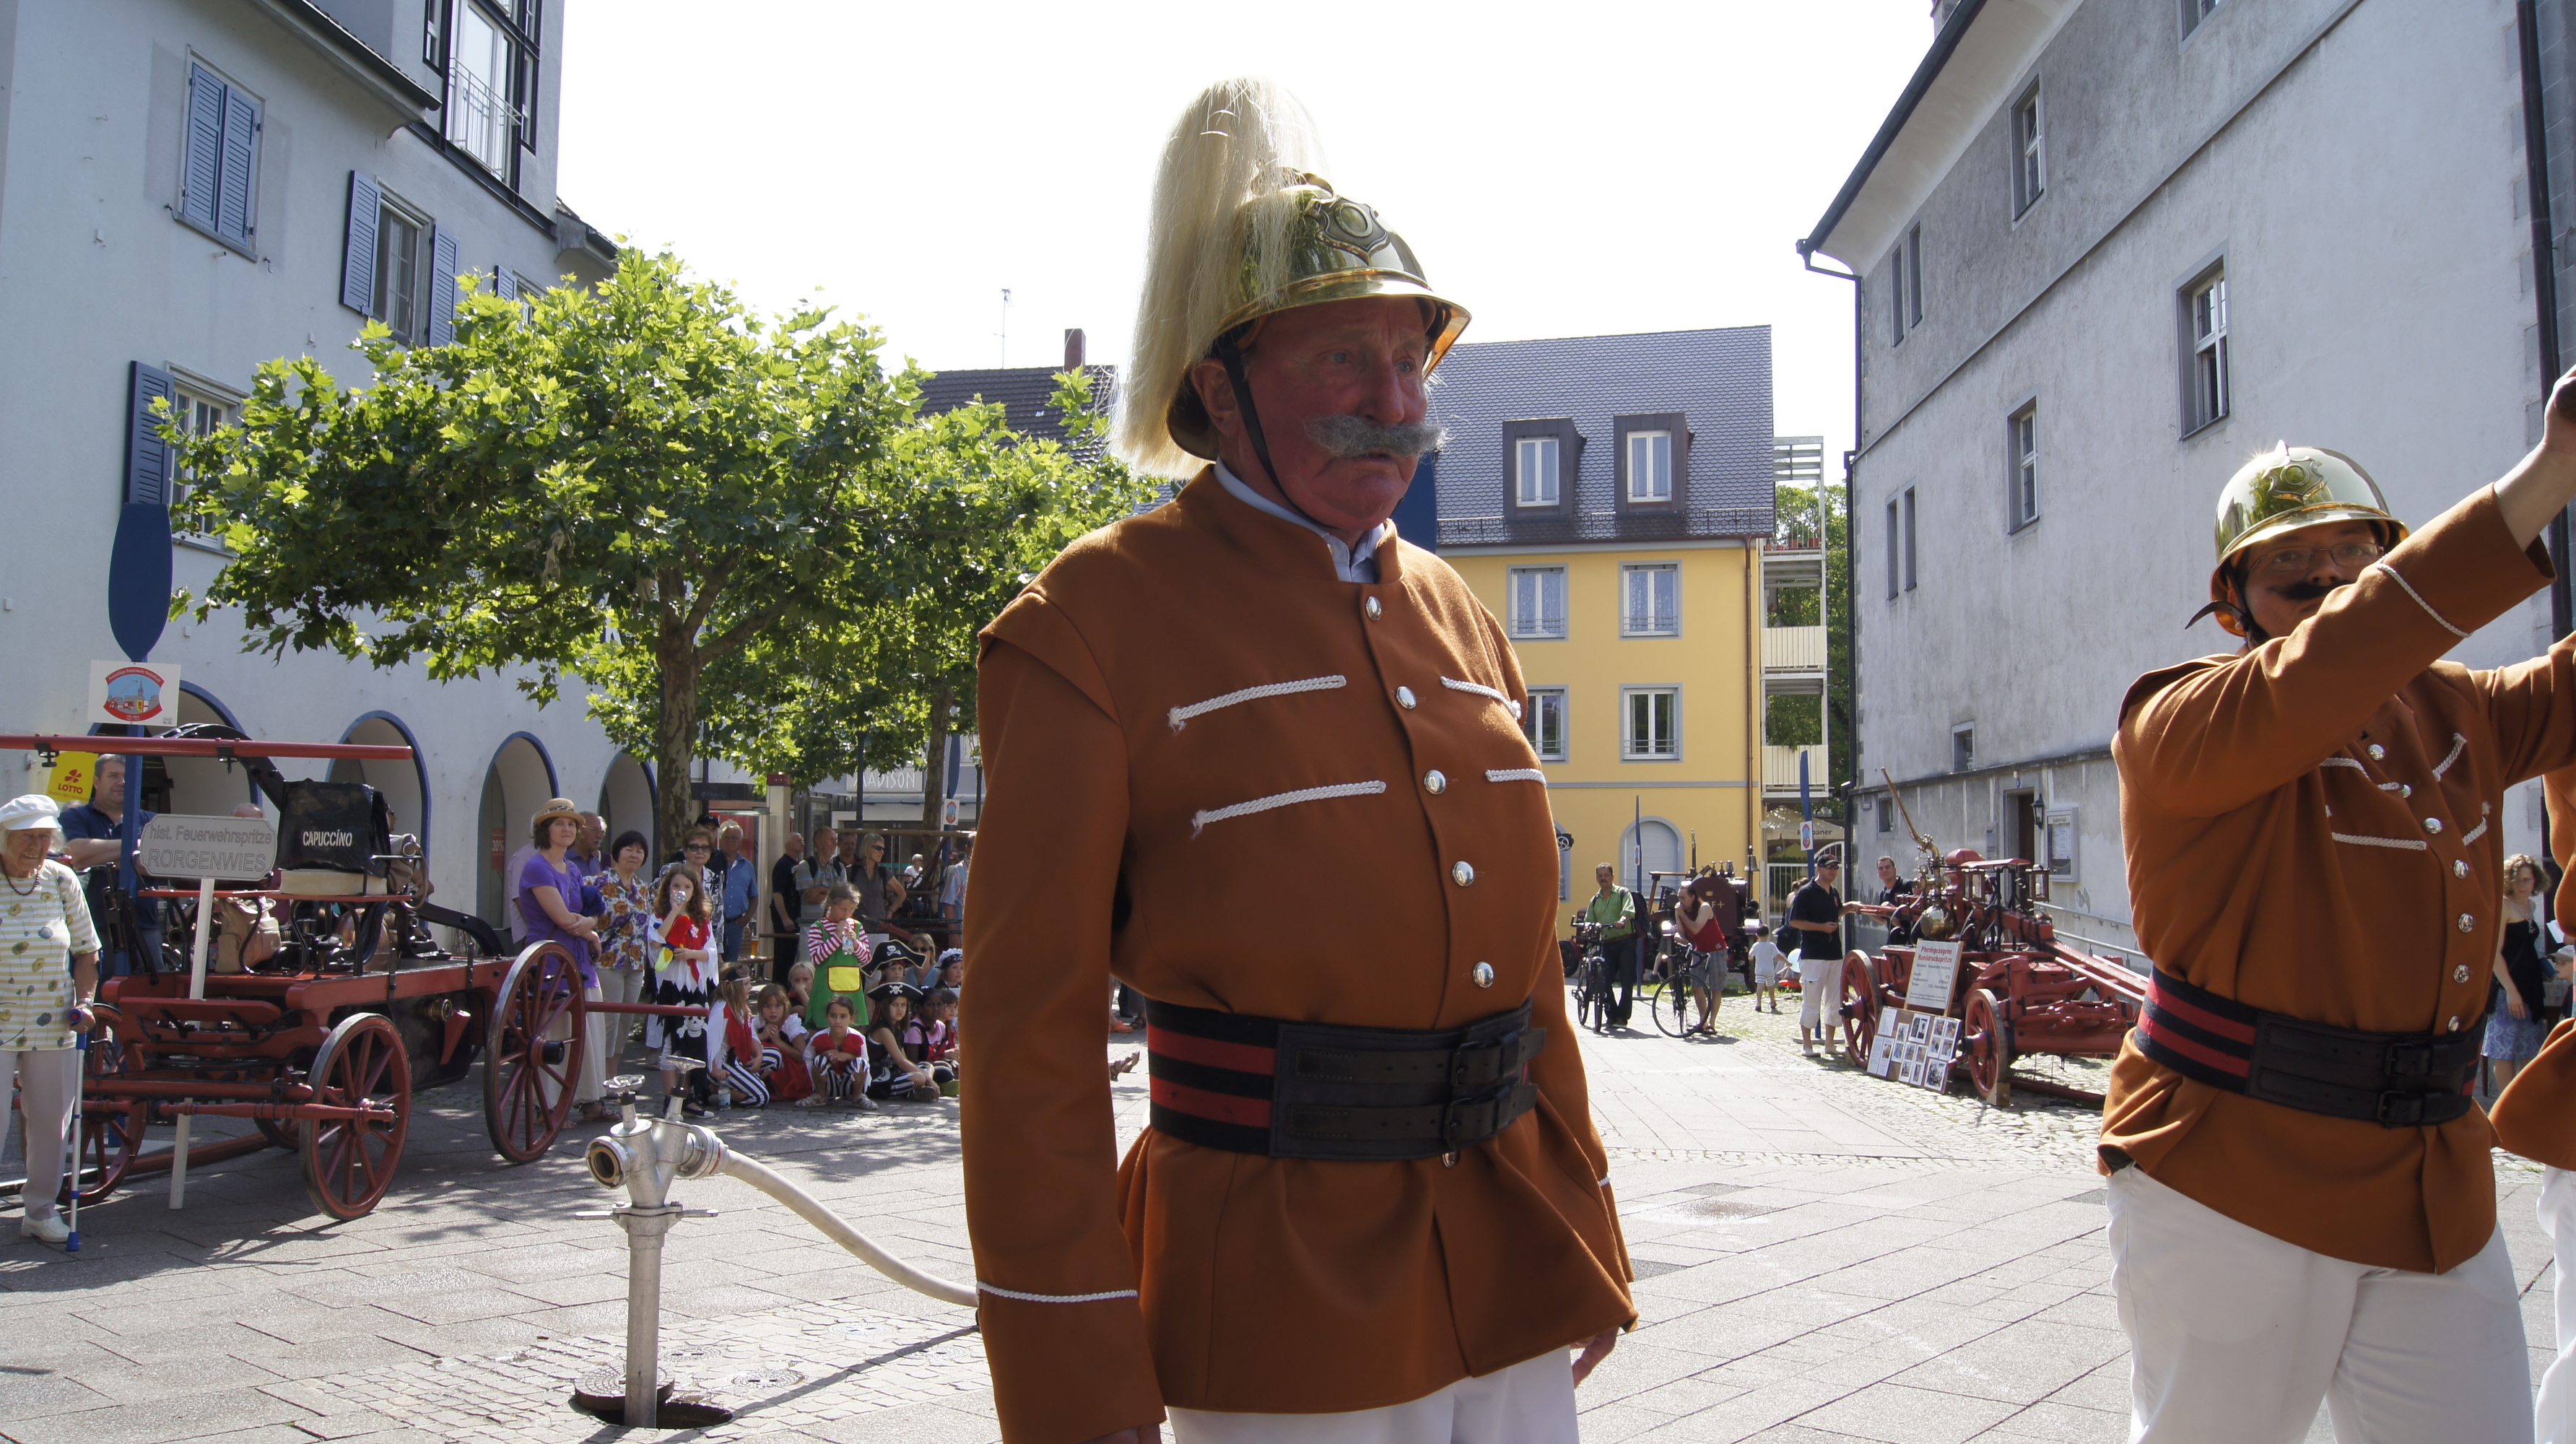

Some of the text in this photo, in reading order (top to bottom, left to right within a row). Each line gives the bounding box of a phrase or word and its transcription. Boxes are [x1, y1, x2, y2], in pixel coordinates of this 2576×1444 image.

[58, 783, 83, 794] LOTTO
[149, 825, 273, 846] hist. Feuerwehrspritze
[492, 840, 505, 852] 30%
[148, 848, 266, 872] RORGENWIES
